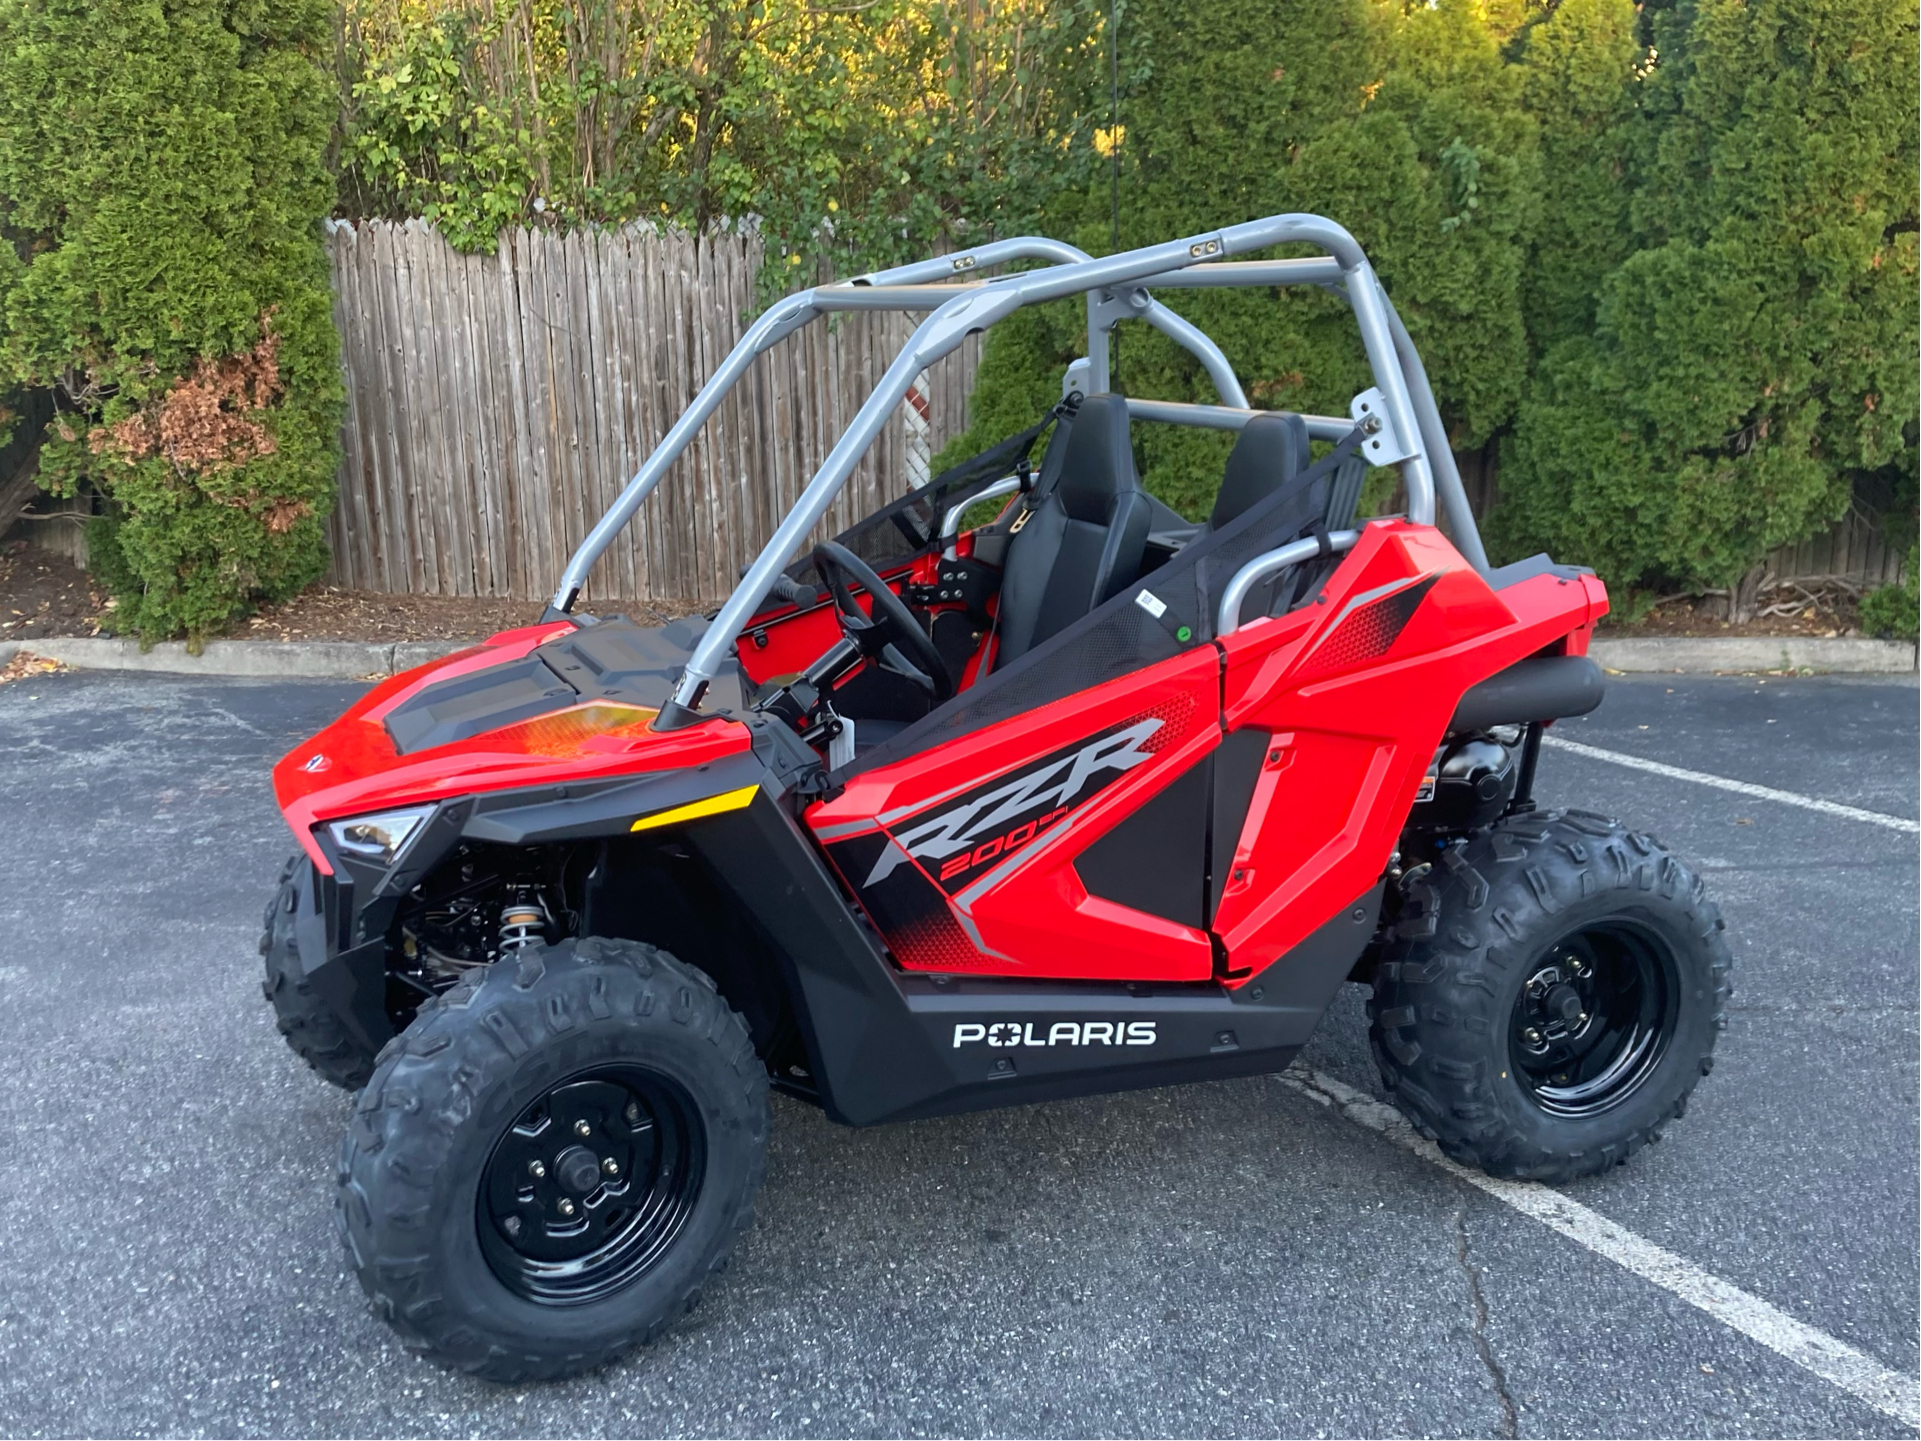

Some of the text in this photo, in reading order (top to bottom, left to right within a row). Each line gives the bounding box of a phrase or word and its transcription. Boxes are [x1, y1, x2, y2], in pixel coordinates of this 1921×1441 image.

[862, 718, 1167, 889] RZR
[940, 819, 1038, 881] 200
[953, 1021, 1157, 1048] POLARIS
[477, 1030, 589, 1130] CST
